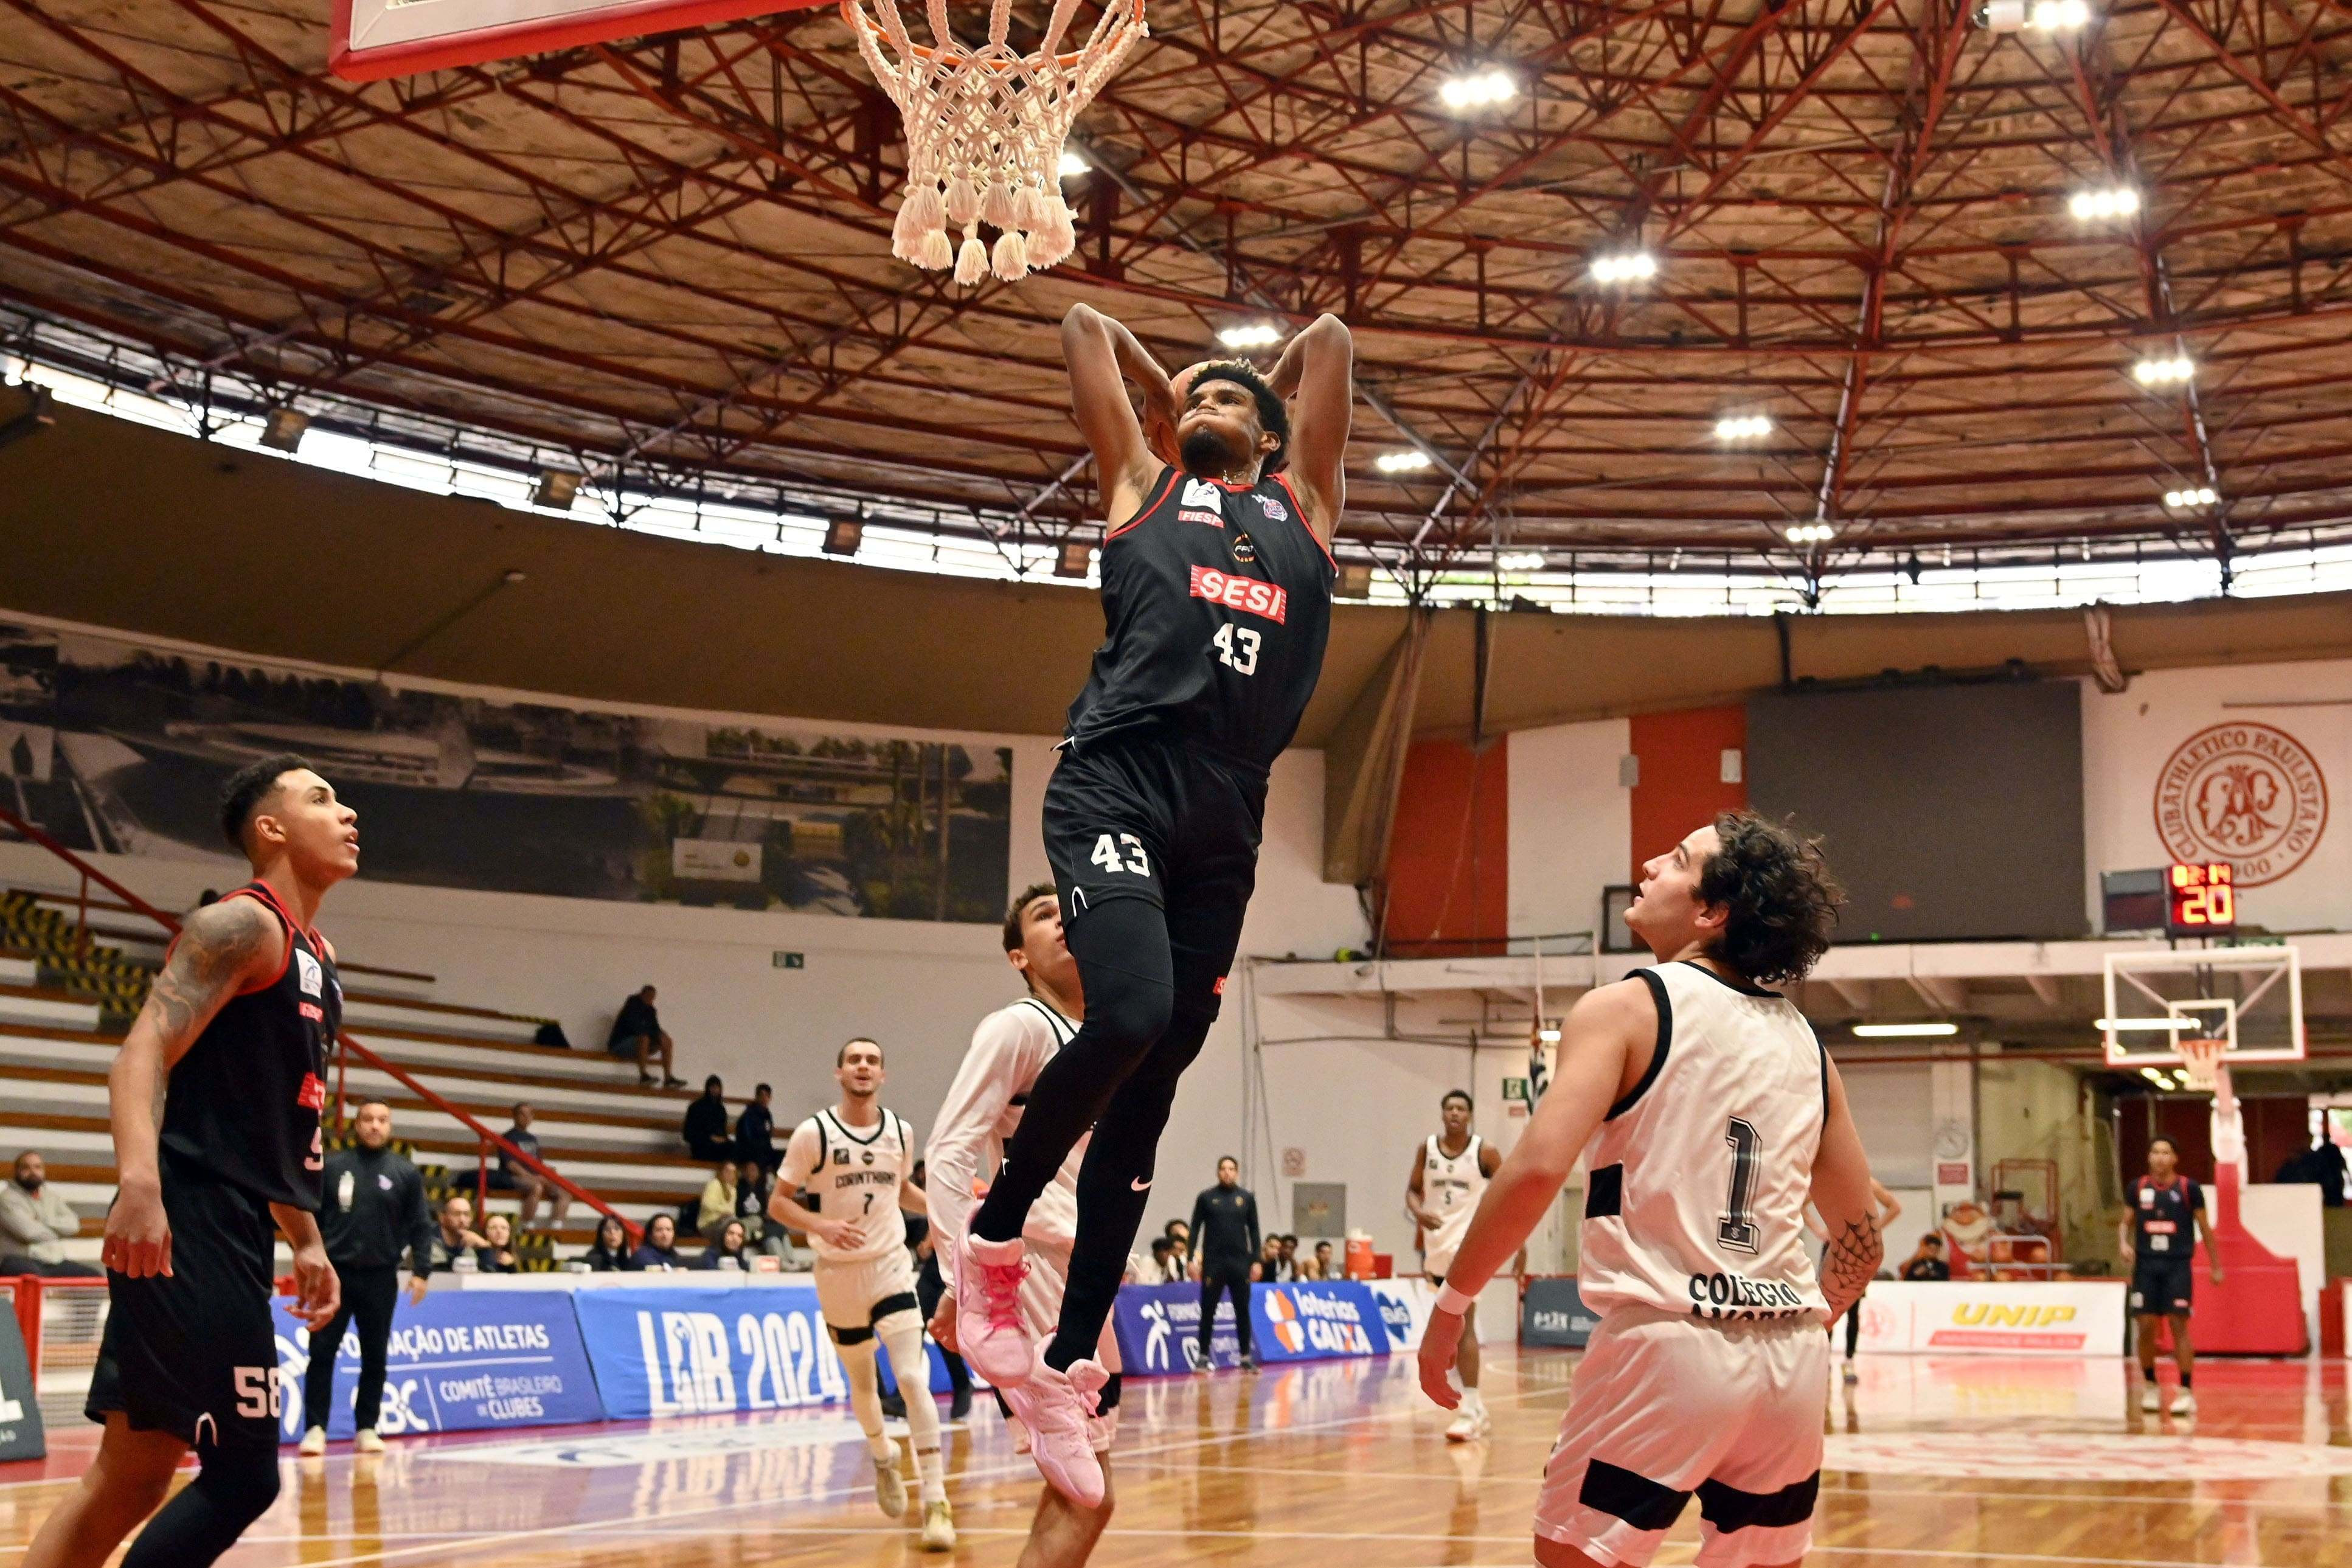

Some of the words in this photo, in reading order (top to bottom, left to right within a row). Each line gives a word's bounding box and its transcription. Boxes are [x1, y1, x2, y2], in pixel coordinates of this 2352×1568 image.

[1182, 512, 1221, 526] FIESP
[1199, 572, 1282, 616] SESI
[1213, 623, 1261, 676] 43
[2163, 730, 2249, 807] ATHLETICO
[2254, 732, 2319, 852] PAULISTANO
[1091, 833, 1151, 878] 43
[2182, 884, 2233, 924] 20
[864, 1193, 874, 1215] 7
[1717, 1115, 1763, 1255] 1
[1292, 1286, 1361, 1323] loterias
[1952, 1302, 2078, 1327] UNIP
[443, 1327, 473, 1353] DE
[473, 1323, 550, 1351] ATLETAS
[1308, 1317, 1375, 1355] CAIXA
[738, 1310, 848, 1409] 2024
[234, 1367, 281, 1418] 58
[439, 1373, 496, 1402] COMITÊ
[487, 1396, 544, 1420] CLUBES
